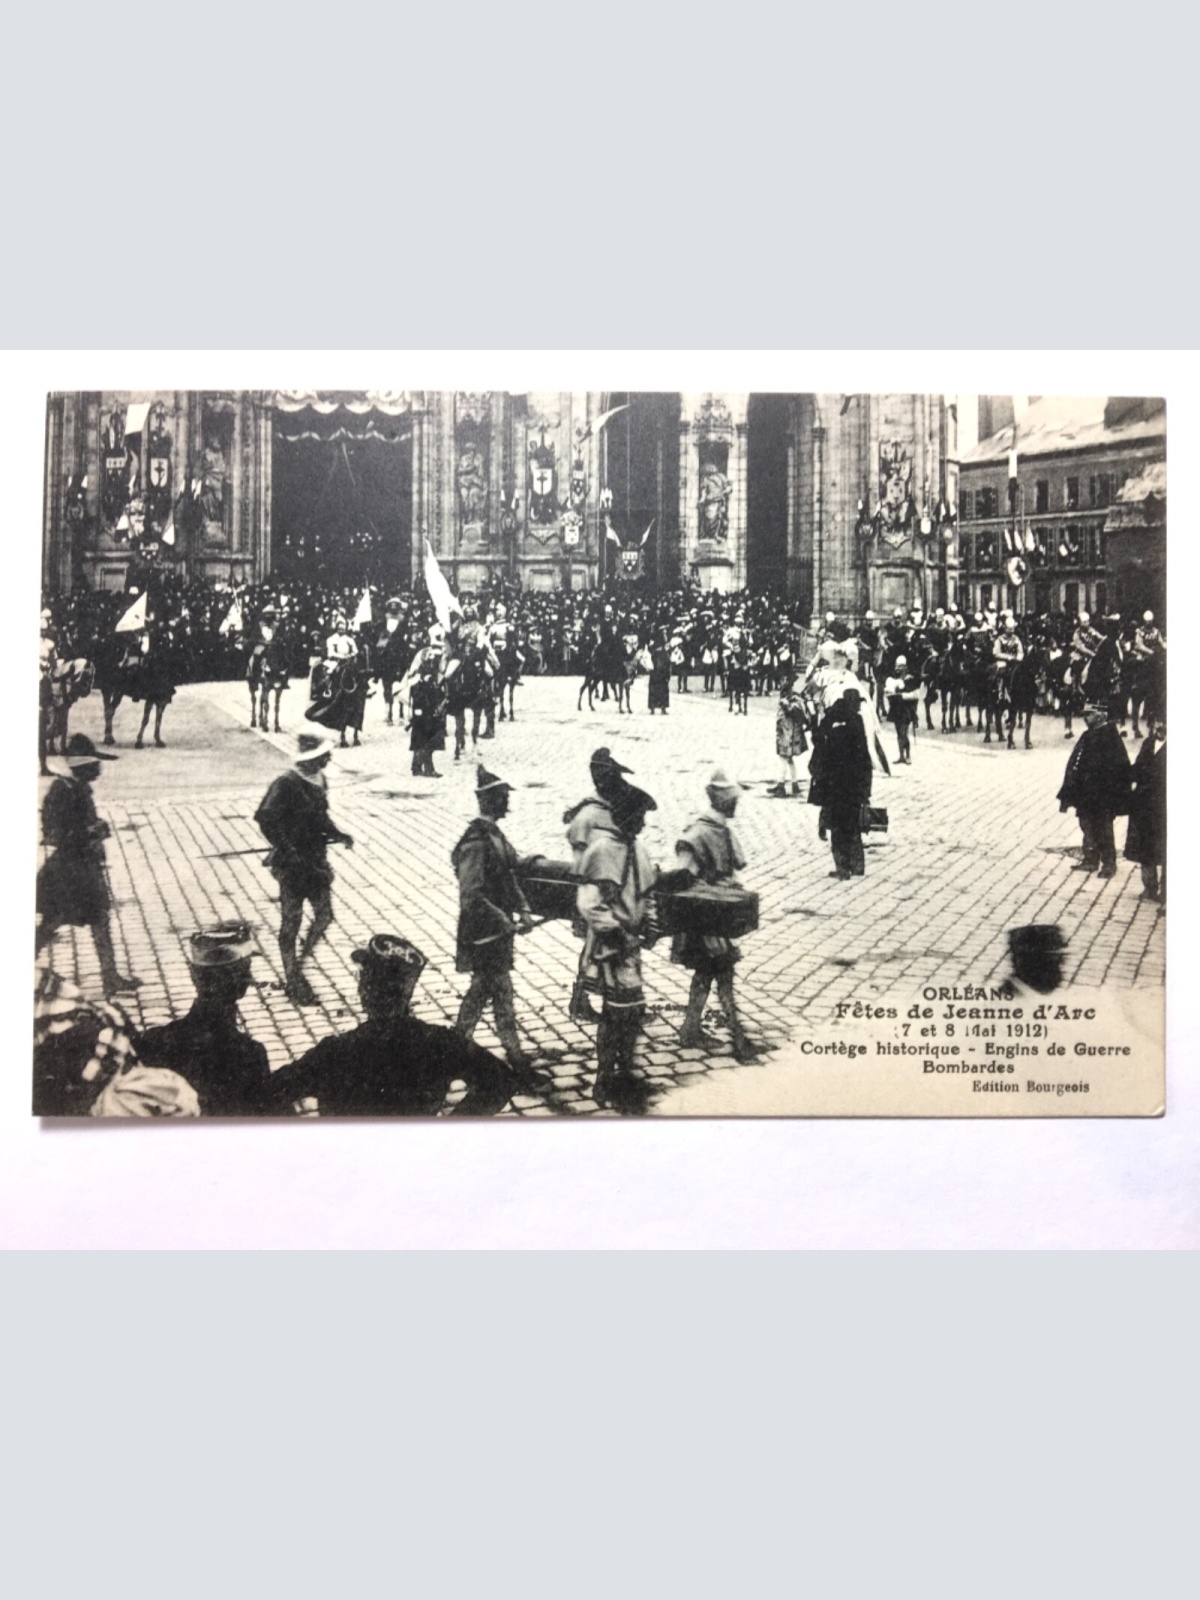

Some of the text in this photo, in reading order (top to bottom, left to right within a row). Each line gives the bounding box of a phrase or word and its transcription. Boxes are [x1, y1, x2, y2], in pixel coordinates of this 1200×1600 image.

[923, 983, 1015, 1001] ORLÉANS
[835, 1001, 1096, 1021] Fêtes de Jeanne d'Arc
[920, 1024, 937, 1037] et
[945, 1023, 955, 1037] 8
[1006, 1023, 1049, 1039] 1912)
[800, 1040, 868, 1059] Cortège
[876, 1041, 961, 1059] historique
[984, 1042, 1039, 1059] Engins
[1046, 1042, 1066, 1056] de
[1073, 1042, 1132, 1056] Guerre
[922, 1060, 1015, 1074] Bombardes
[972, 1080, 1090, 1096] Edition Bourgeois
